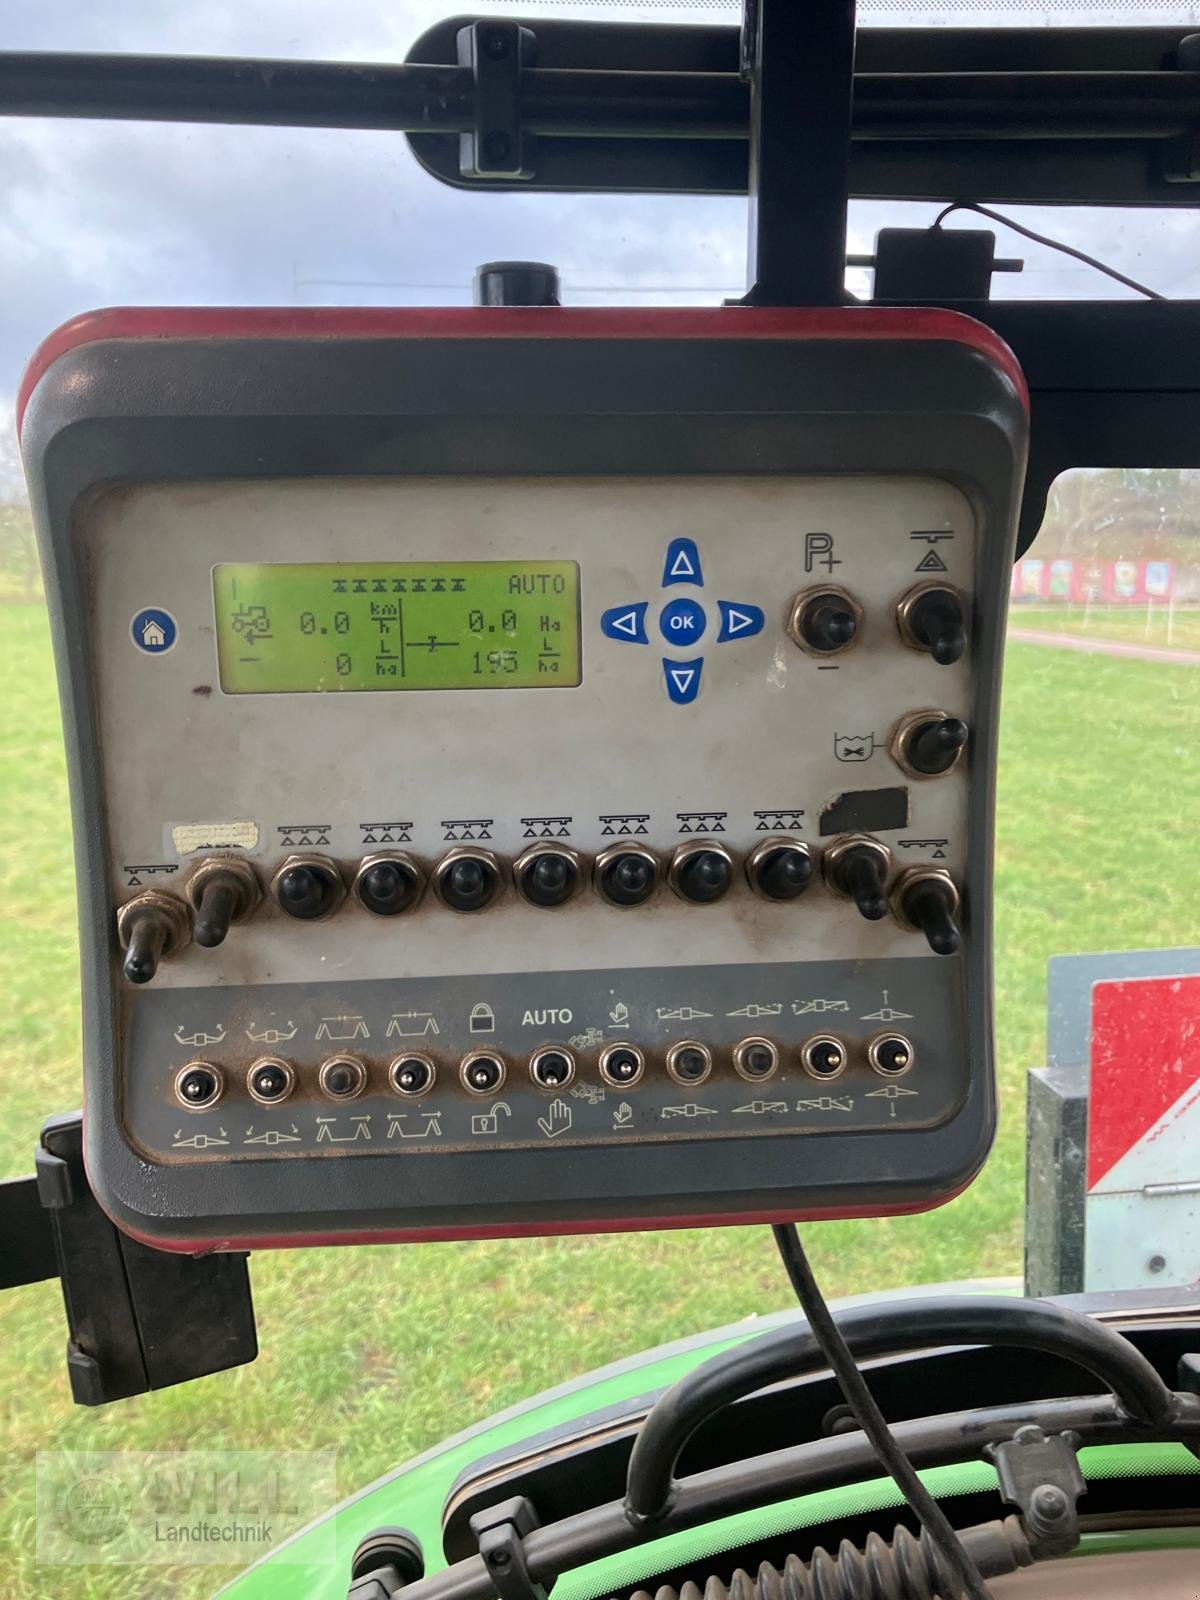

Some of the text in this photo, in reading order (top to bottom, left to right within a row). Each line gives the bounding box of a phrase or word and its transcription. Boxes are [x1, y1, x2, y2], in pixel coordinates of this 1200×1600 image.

[509, 574, 564, 594] AUTO
[370, 602, 397, 615] km
[300, 612, 349, 634] 0.0
[469, 610, 516, 632] 0.0
[540, 616, 560, 632] Ha
[670, 617, 694, 629] OK
[337, 653, 351, 676] 0
[376, 663, 397, 676] ha
[473, 651, 517, 674] 195
[538, 660, 558, 673] ha
[522, 1008, 573, 1025] AUTO
